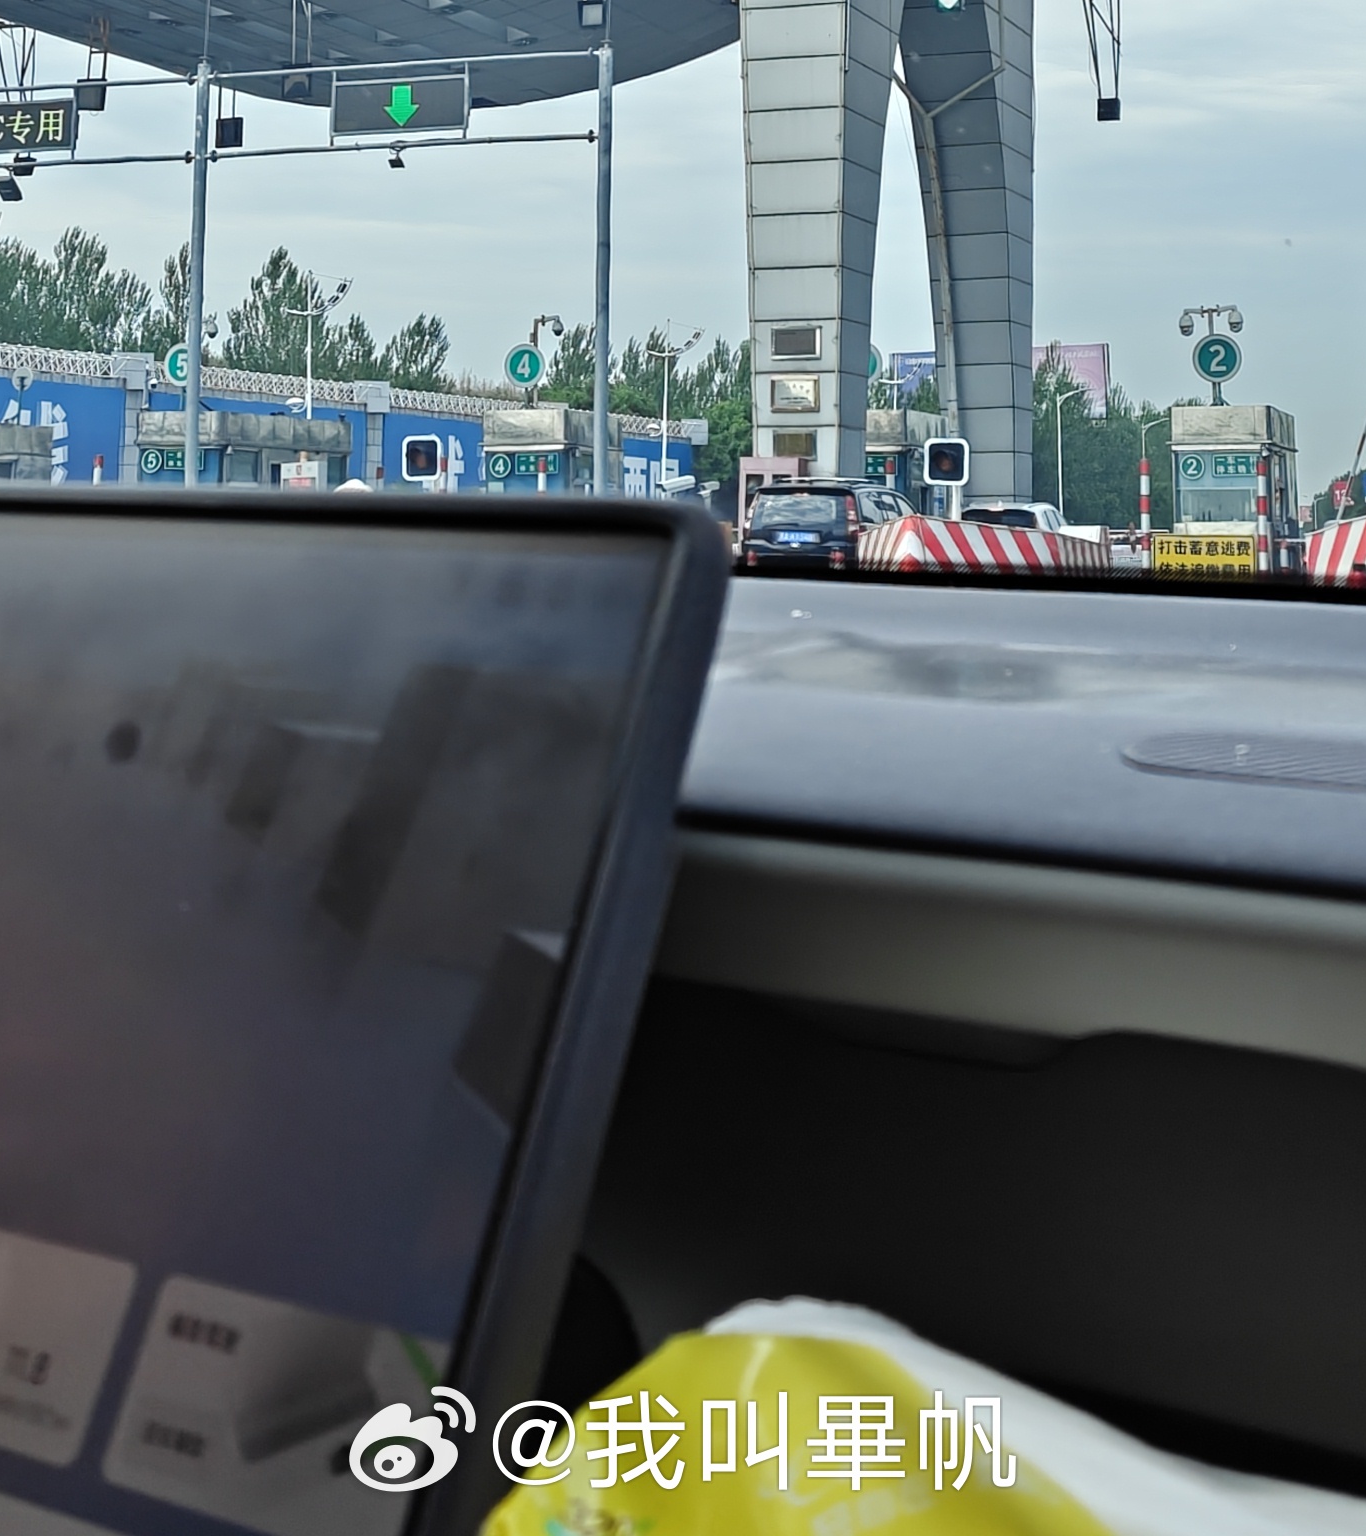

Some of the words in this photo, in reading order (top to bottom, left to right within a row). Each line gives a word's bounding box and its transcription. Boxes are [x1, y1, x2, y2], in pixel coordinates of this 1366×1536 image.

[176, 355, 188, 378] 5
[517, 353, 531, 378] 4
[1209, 344, 1227, 372] 2
[147, 453, 156, 469] 5
[495, 458, 505, 474] 4
[1186, 458, 1197, 475] 2
[1158, 540, 1250, 556] 打击蓄意逃费
